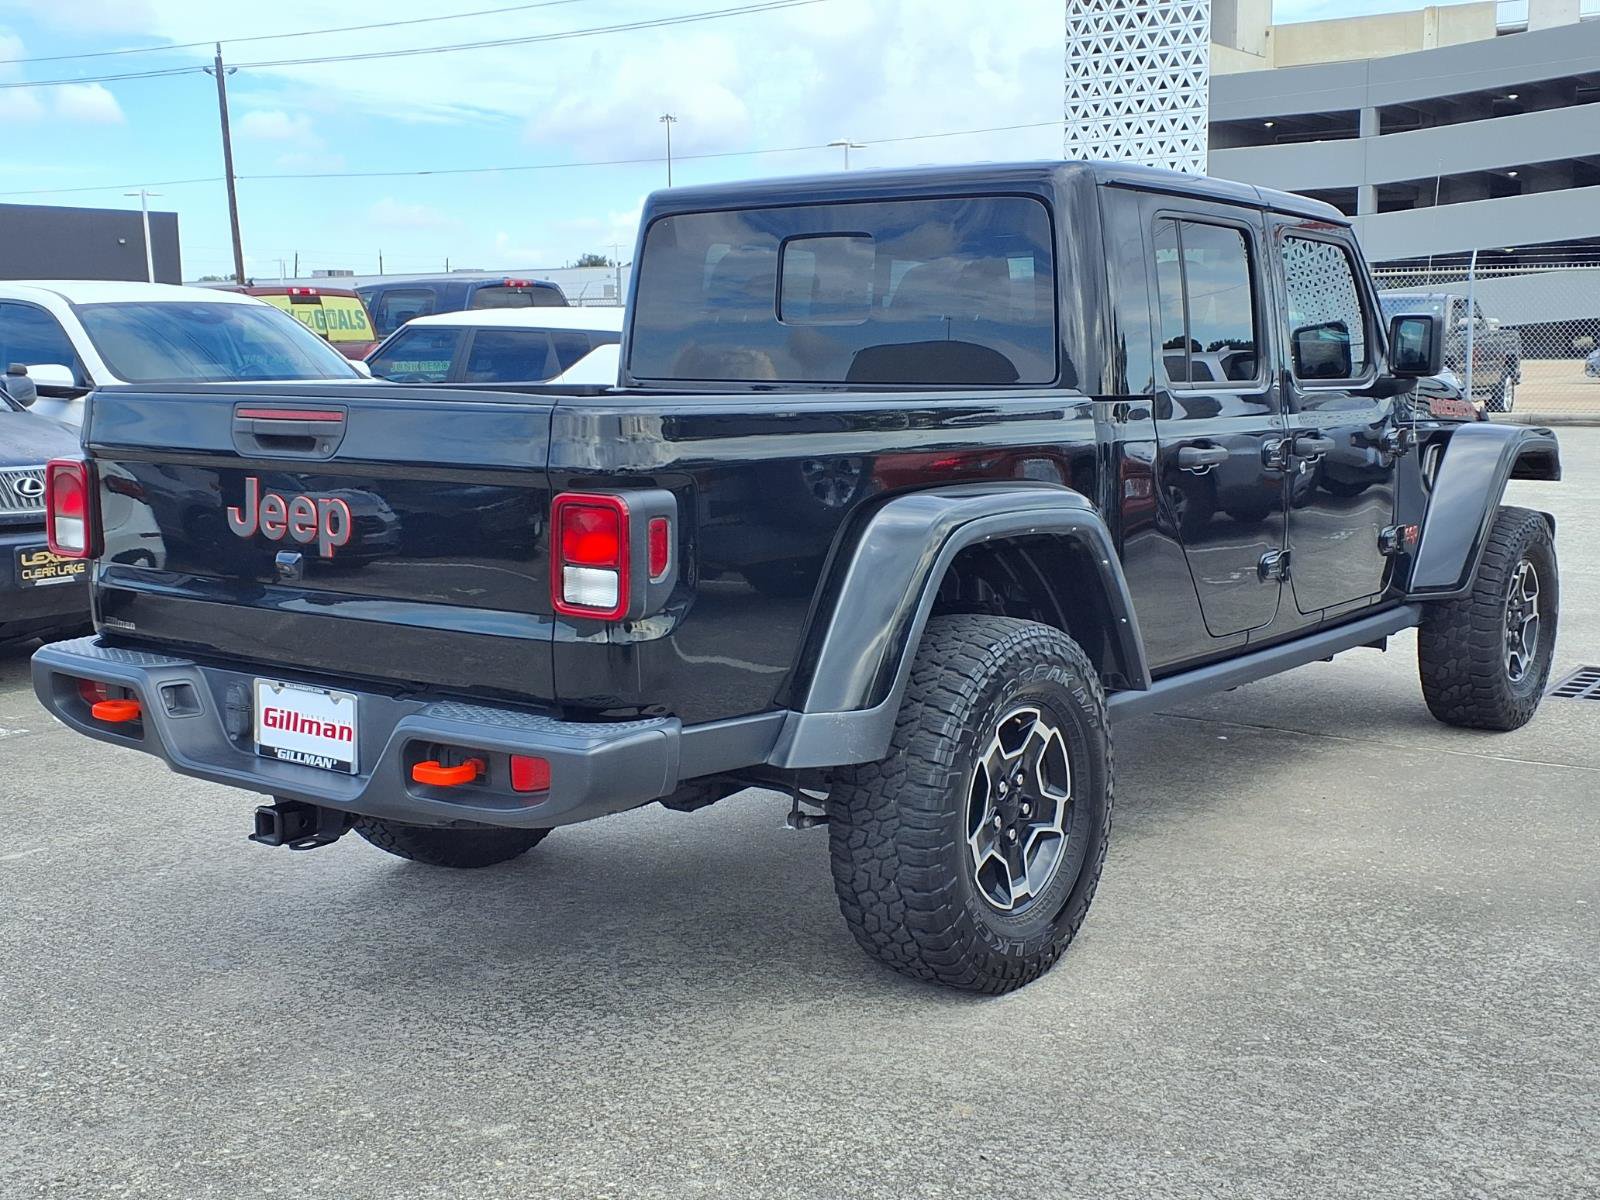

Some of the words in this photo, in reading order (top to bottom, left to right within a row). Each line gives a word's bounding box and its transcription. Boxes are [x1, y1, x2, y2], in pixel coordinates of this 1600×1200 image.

[227, 477, 351, 559] Jeep
[21, 551, 80, 566] LEX
[22, 567, 56, 580] CLEAR
[58, 563, 85, 575] LAKE
[264, 707, 353, 742] Gillman
